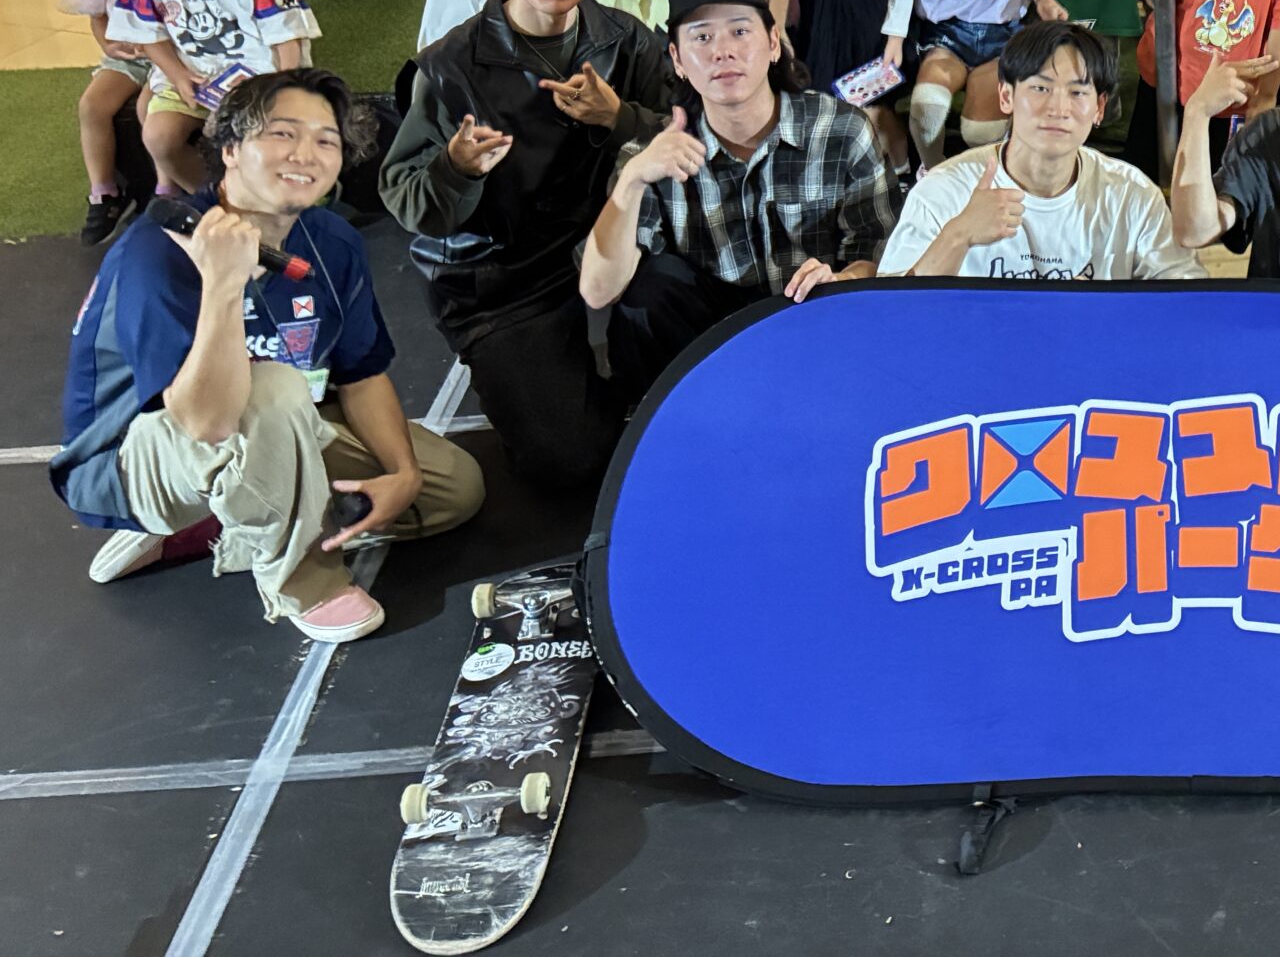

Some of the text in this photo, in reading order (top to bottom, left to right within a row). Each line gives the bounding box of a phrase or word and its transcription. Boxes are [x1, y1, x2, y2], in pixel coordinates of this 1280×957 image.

[1020, 253, 1064, 265] YOKOHAMA
[900, 544, 1060, 593] X-CROSS
[1008, 577, 1058, 602] PA
